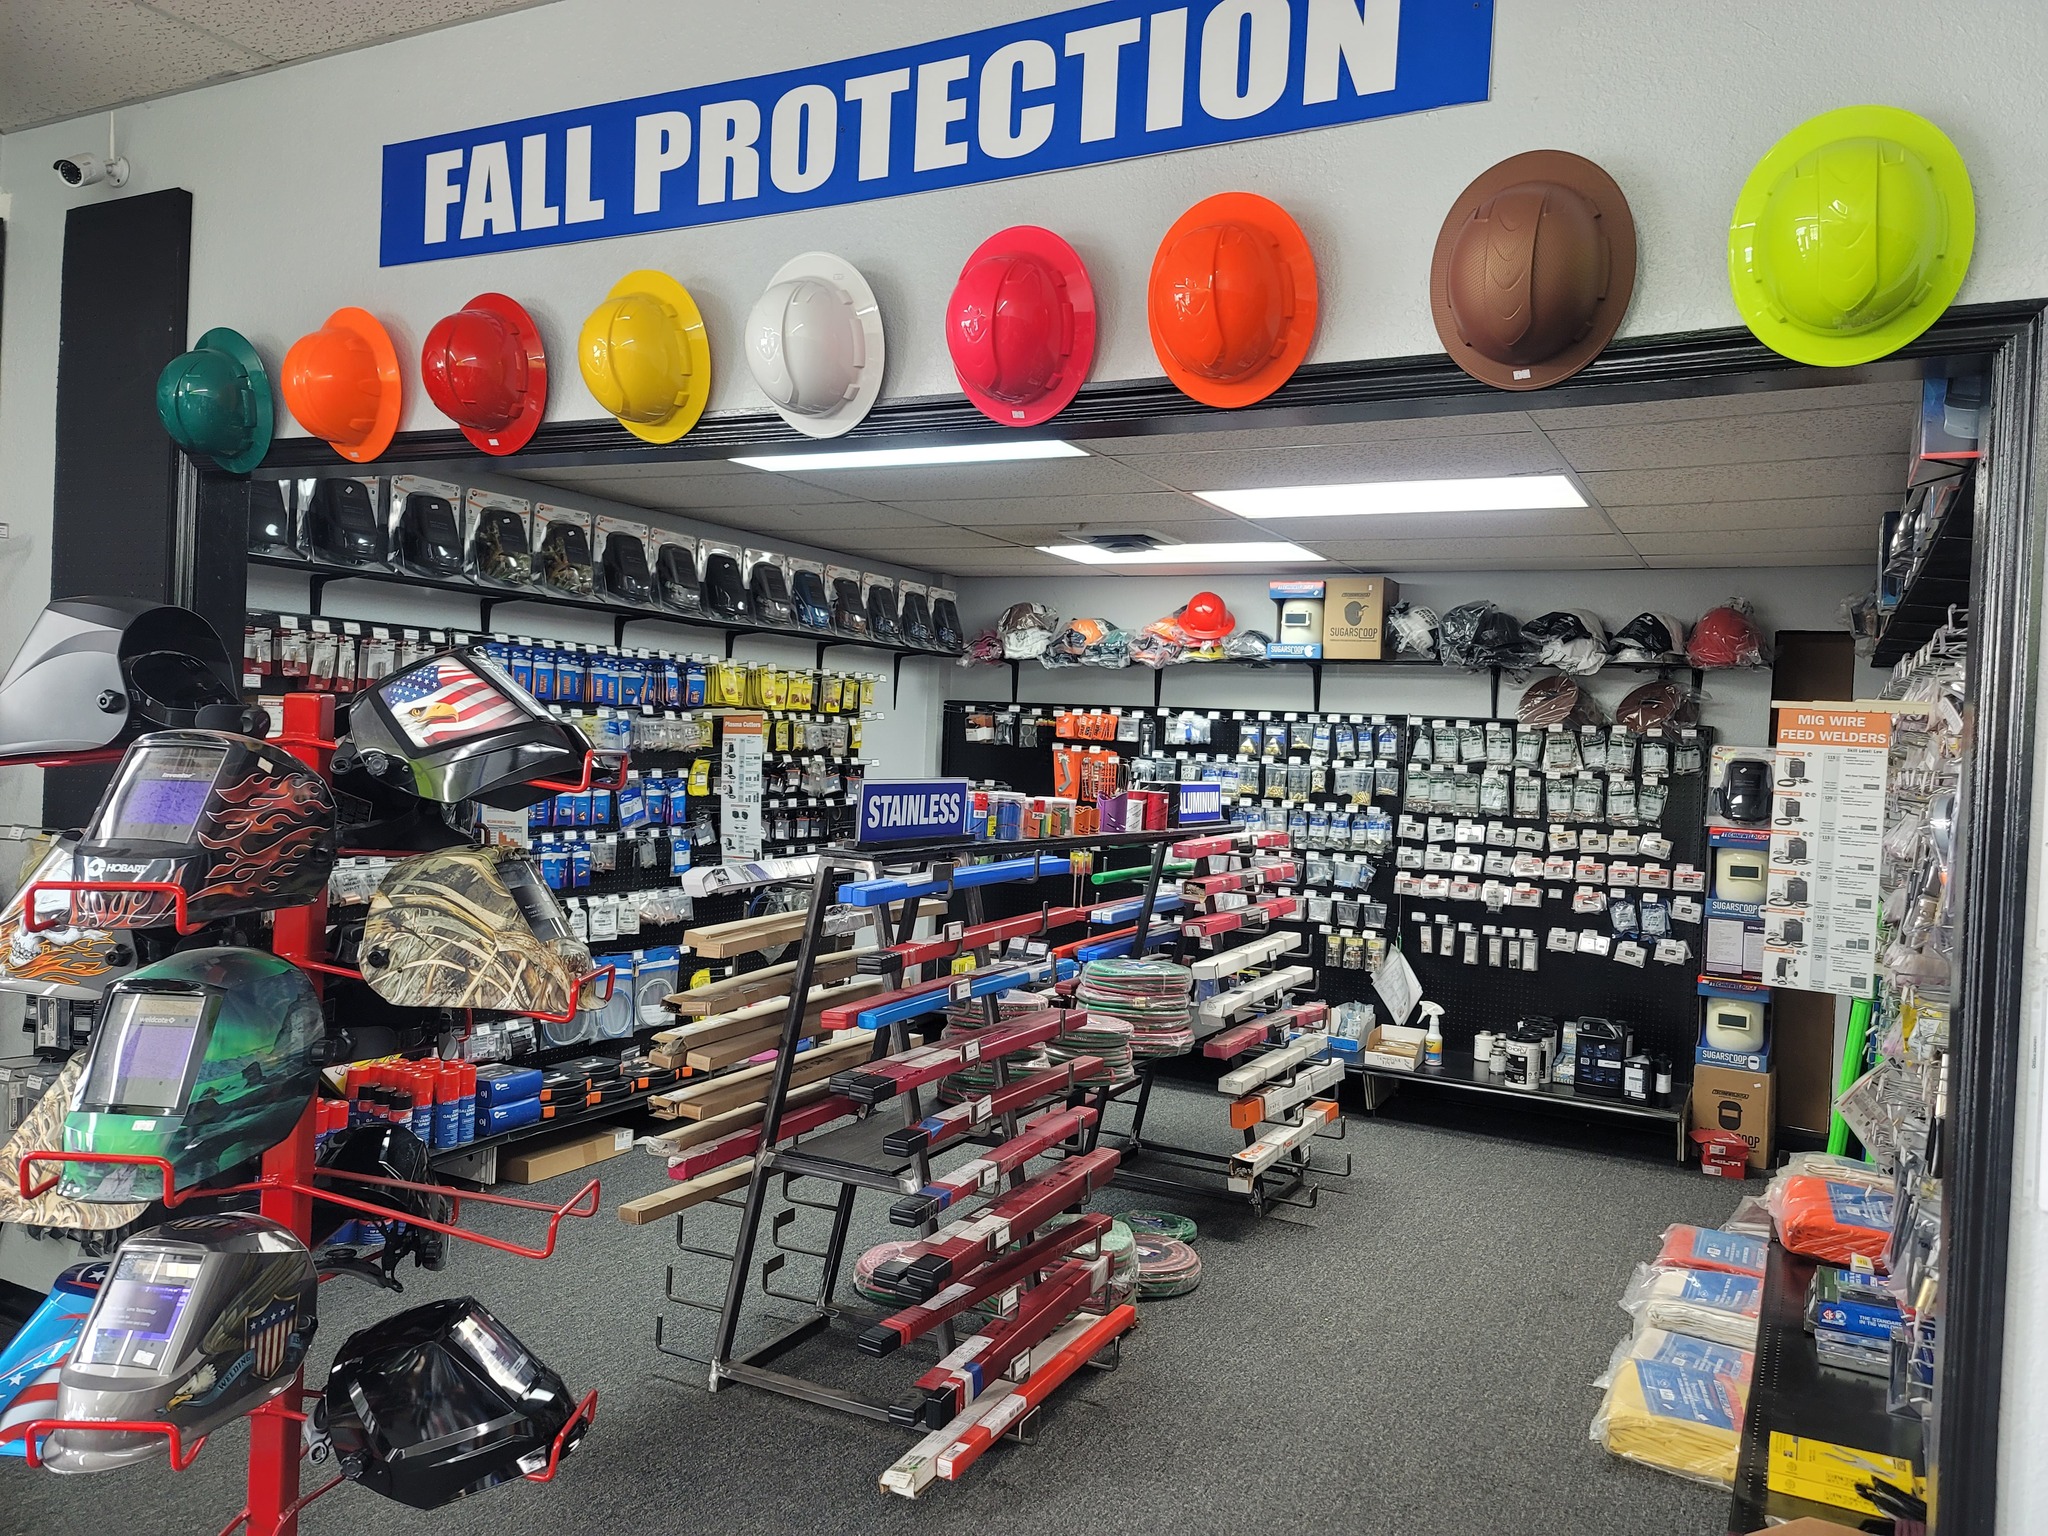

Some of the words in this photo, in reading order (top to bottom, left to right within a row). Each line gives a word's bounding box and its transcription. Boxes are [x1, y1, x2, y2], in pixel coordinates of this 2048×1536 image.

[422, 125, 606, 246] FALL
[632, 0, 1403, 215] PROTECTION
[1330, 627, 1378, 639] SUGARSCOOP
[1270, 644, 1305, 655] SUGARSCOOP
[1797, 713, 1824, 726] MIG
[1829, 715, 1866, 728] WIRE
[1780, 729, 1815, 741] FEED
[1819, 731, 1887, 744] WELDERS
[1180, 790, 1220, 815] ALUMINUM
[867, 792, 961, 831] STAINLESS
[106, 863, 148, 874] HOBART
[1712, 901, 1758, 914] SUGARSCOOP
[1702, 1050, 1749, 1064] SUGARSCOOP
[217, 1352, 252, 1391] WELDING
